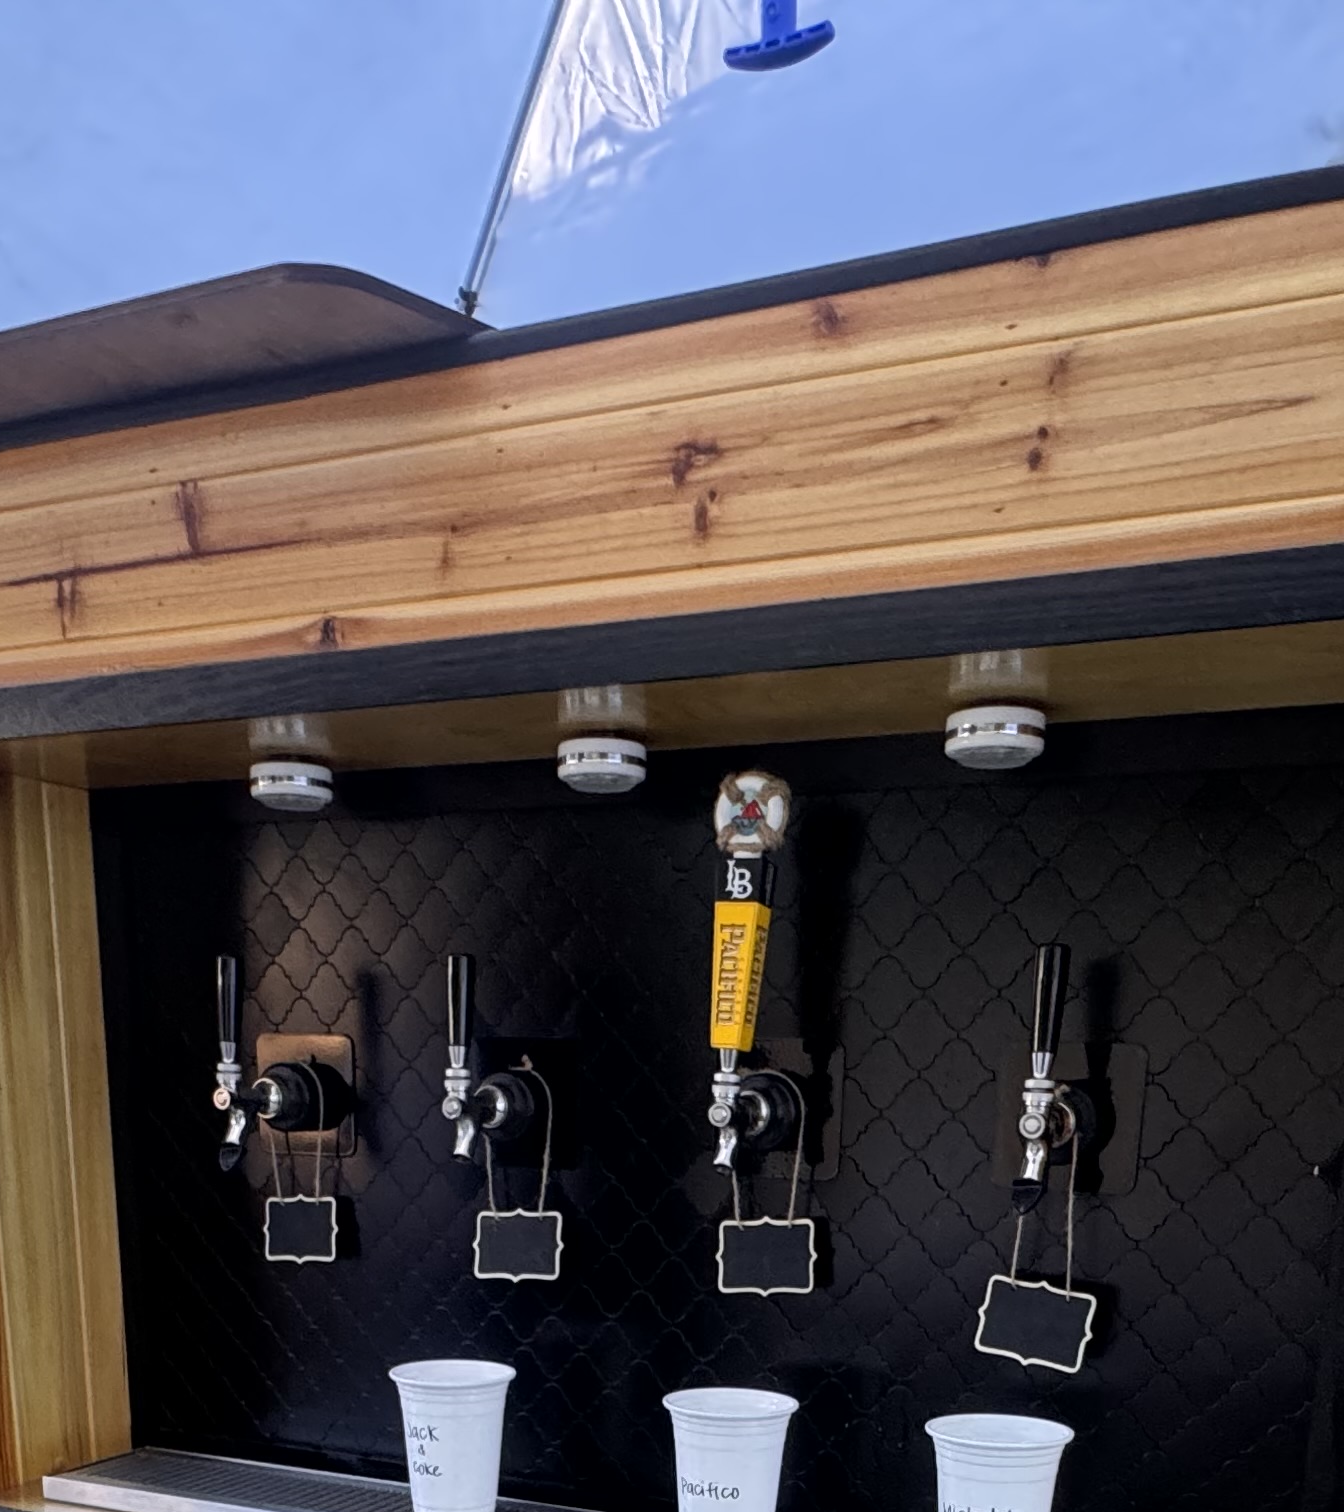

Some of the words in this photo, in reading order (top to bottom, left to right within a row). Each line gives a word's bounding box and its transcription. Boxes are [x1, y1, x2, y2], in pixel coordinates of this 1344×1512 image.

[725, 859, 753, 899] LB
[407, 1421, 440, 1442] Jack
[417, 1444, 426, 1456] &
[680, 1476, 740, 1500] Pacifico
